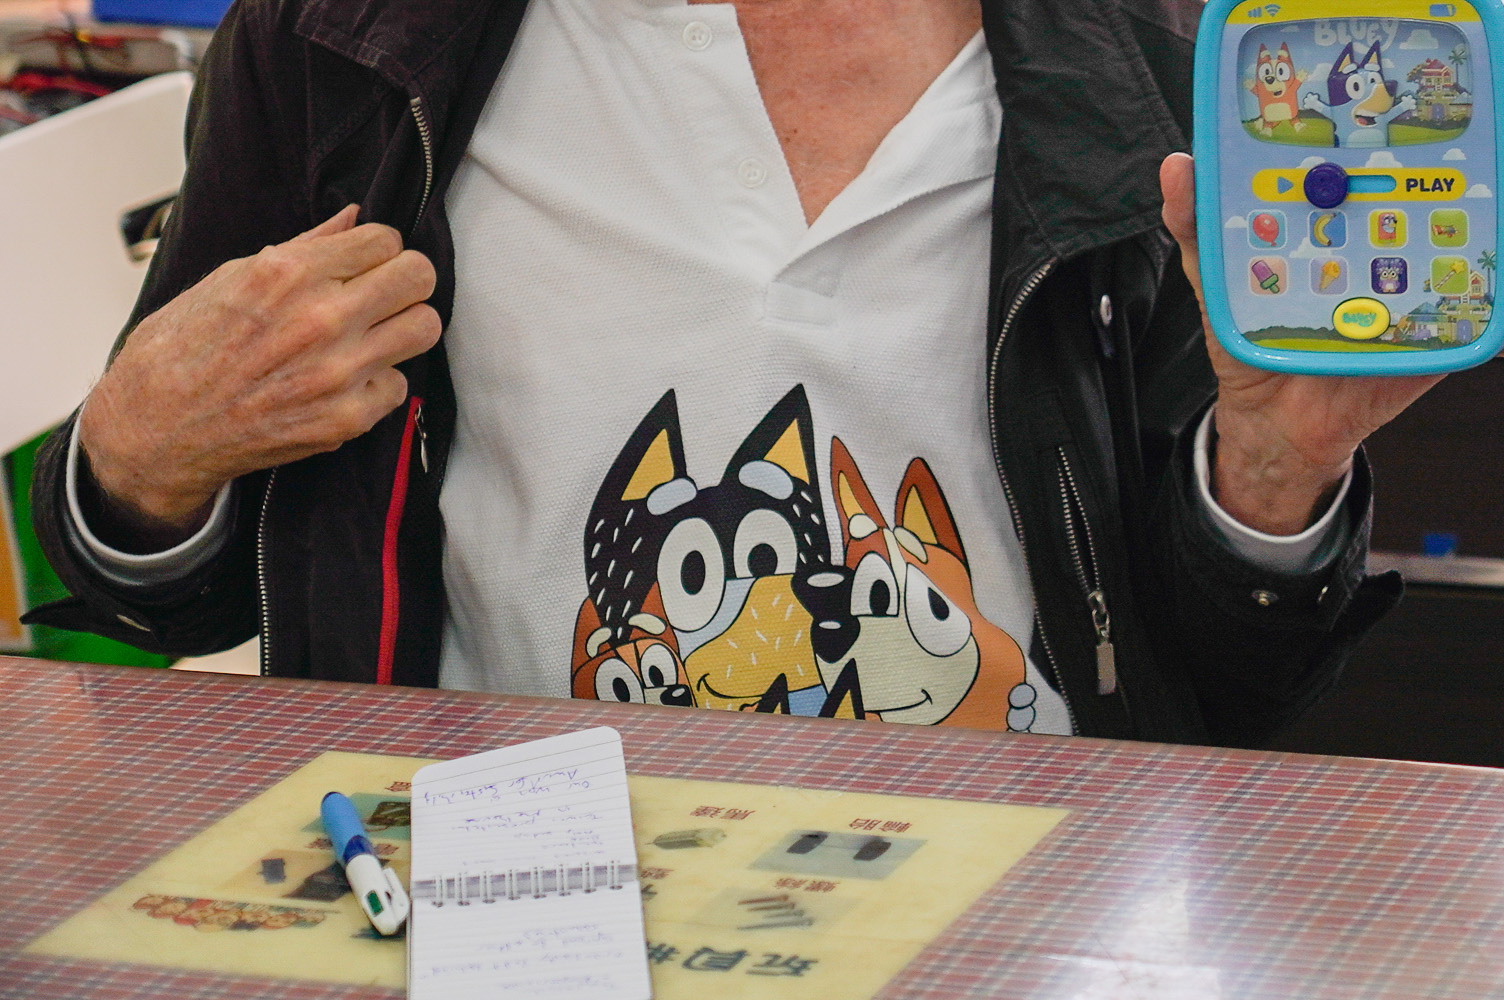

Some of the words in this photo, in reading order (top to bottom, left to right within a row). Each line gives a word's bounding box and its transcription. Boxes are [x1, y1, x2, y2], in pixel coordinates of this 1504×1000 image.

[1405, 177, 1456, 194] PLAY
[689, 805, 757, 822] 馬達
[847, 817, 913, 834] 輪胎
